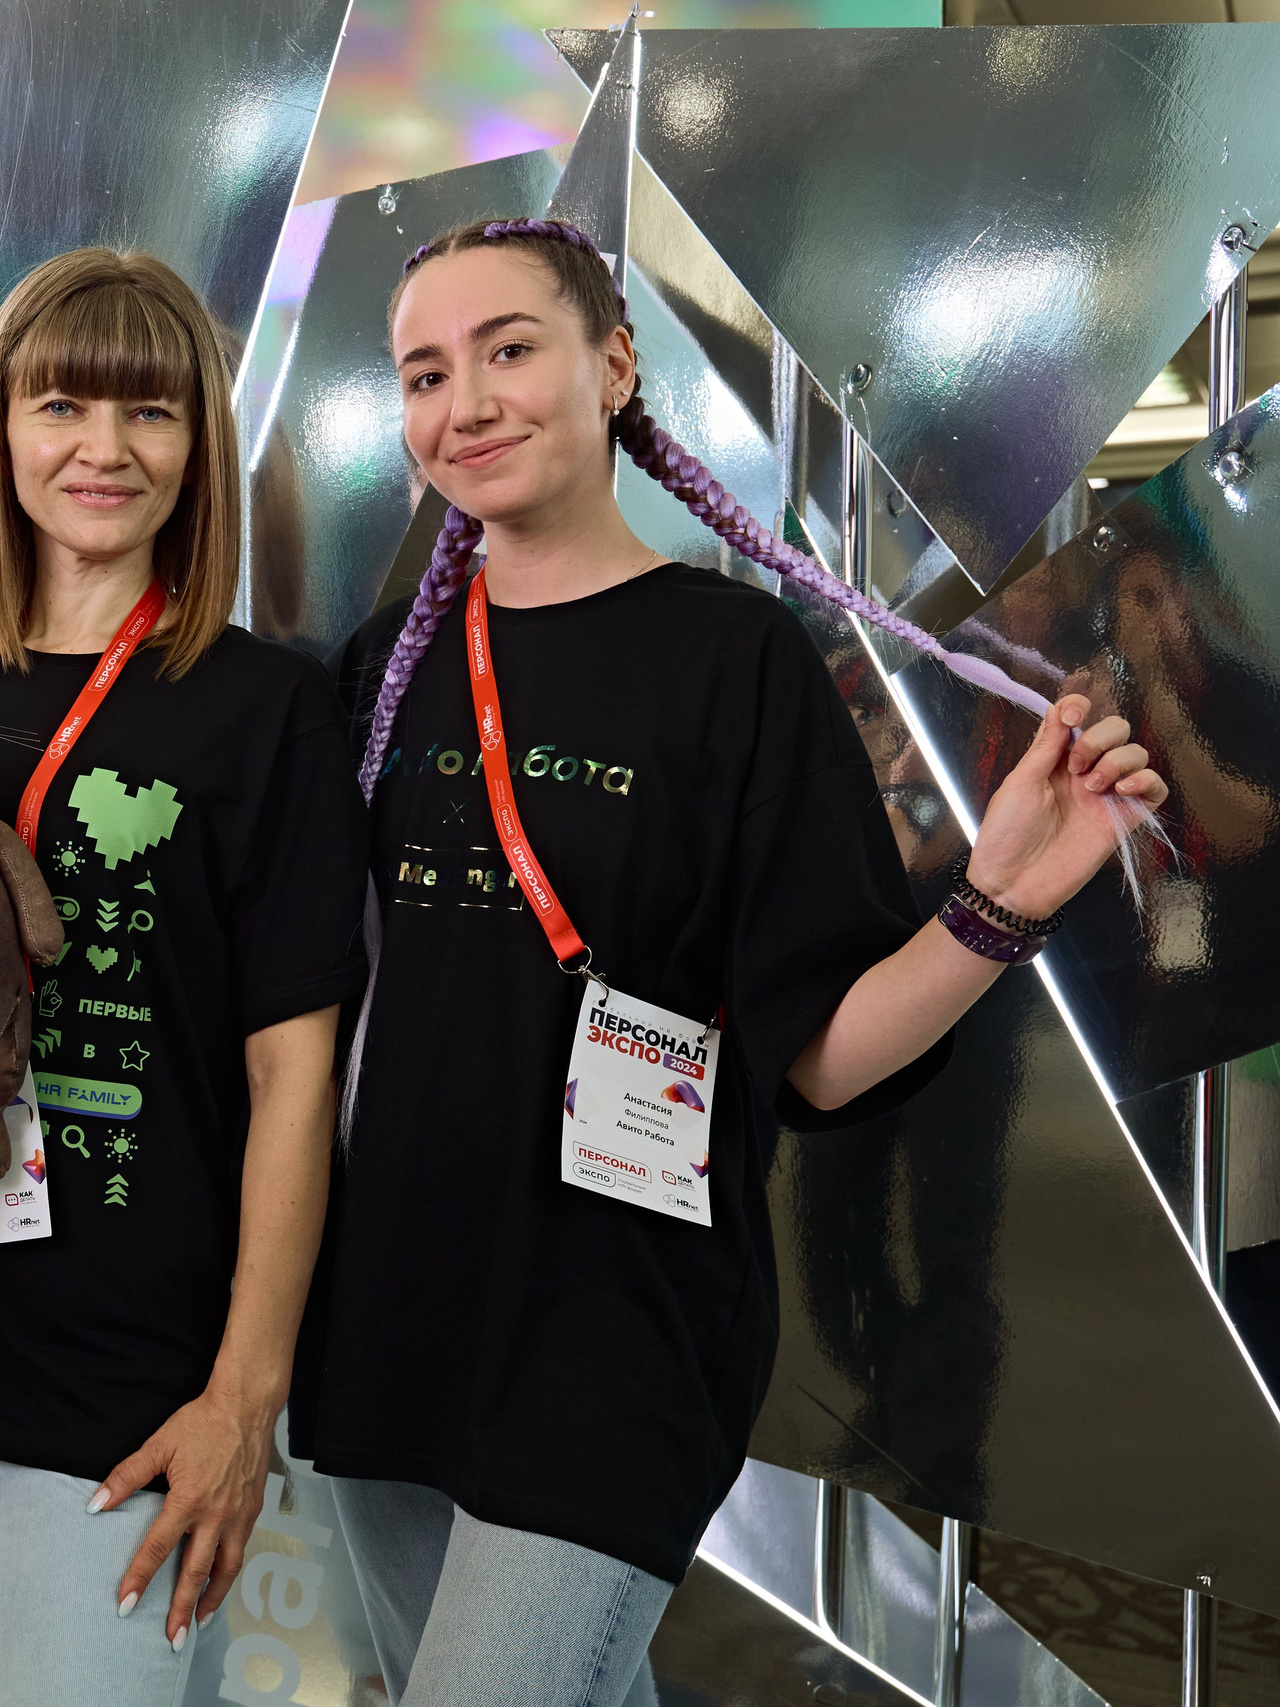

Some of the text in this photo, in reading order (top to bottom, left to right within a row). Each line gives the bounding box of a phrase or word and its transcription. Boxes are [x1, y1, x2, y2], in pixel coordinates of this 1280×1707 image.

[128, 616, 146, 637] ЭКСПО
[472, 624, 486, 675] ПЕРСОНАЛ
[94, 641, 129, 689] ПЕРСОНАЛ
[58, 716, 82, 743] HRnet
[483, 704, 495, 735] HRnet
[501, 809, 514, 837] ЭКСПО
[512, 845, 551, 909] ПЕРСОНАЛ
[78, 998, 152, 1022] ПЕРВЫЕ
[592, 1000, 652, 1027] Гобальный
[589, 1007, 708, 1065] ПЕРСОНАЛ
[586, 1025, 698, 1076] ЭКСПО 2024
[37, 1081, 132, 1106] HR FAMILY
[623, 1092, 673, 1117] Анастасия
[624, 1108, 669, 1130] Филиппова
[615, 1120, 675, 1147] Авито Работа
[578, 1147, 646, 1177] ПЕРСОНАЛ
[578, 1167, 610, 1182] ЭКСПО
[677, 1175, 693, 1185] КАК
[19, 1190, 33, 1198] КАК
[676, 1198, 699, 1211] HRnet
[20, 1217, 40, 1226] HRnet
